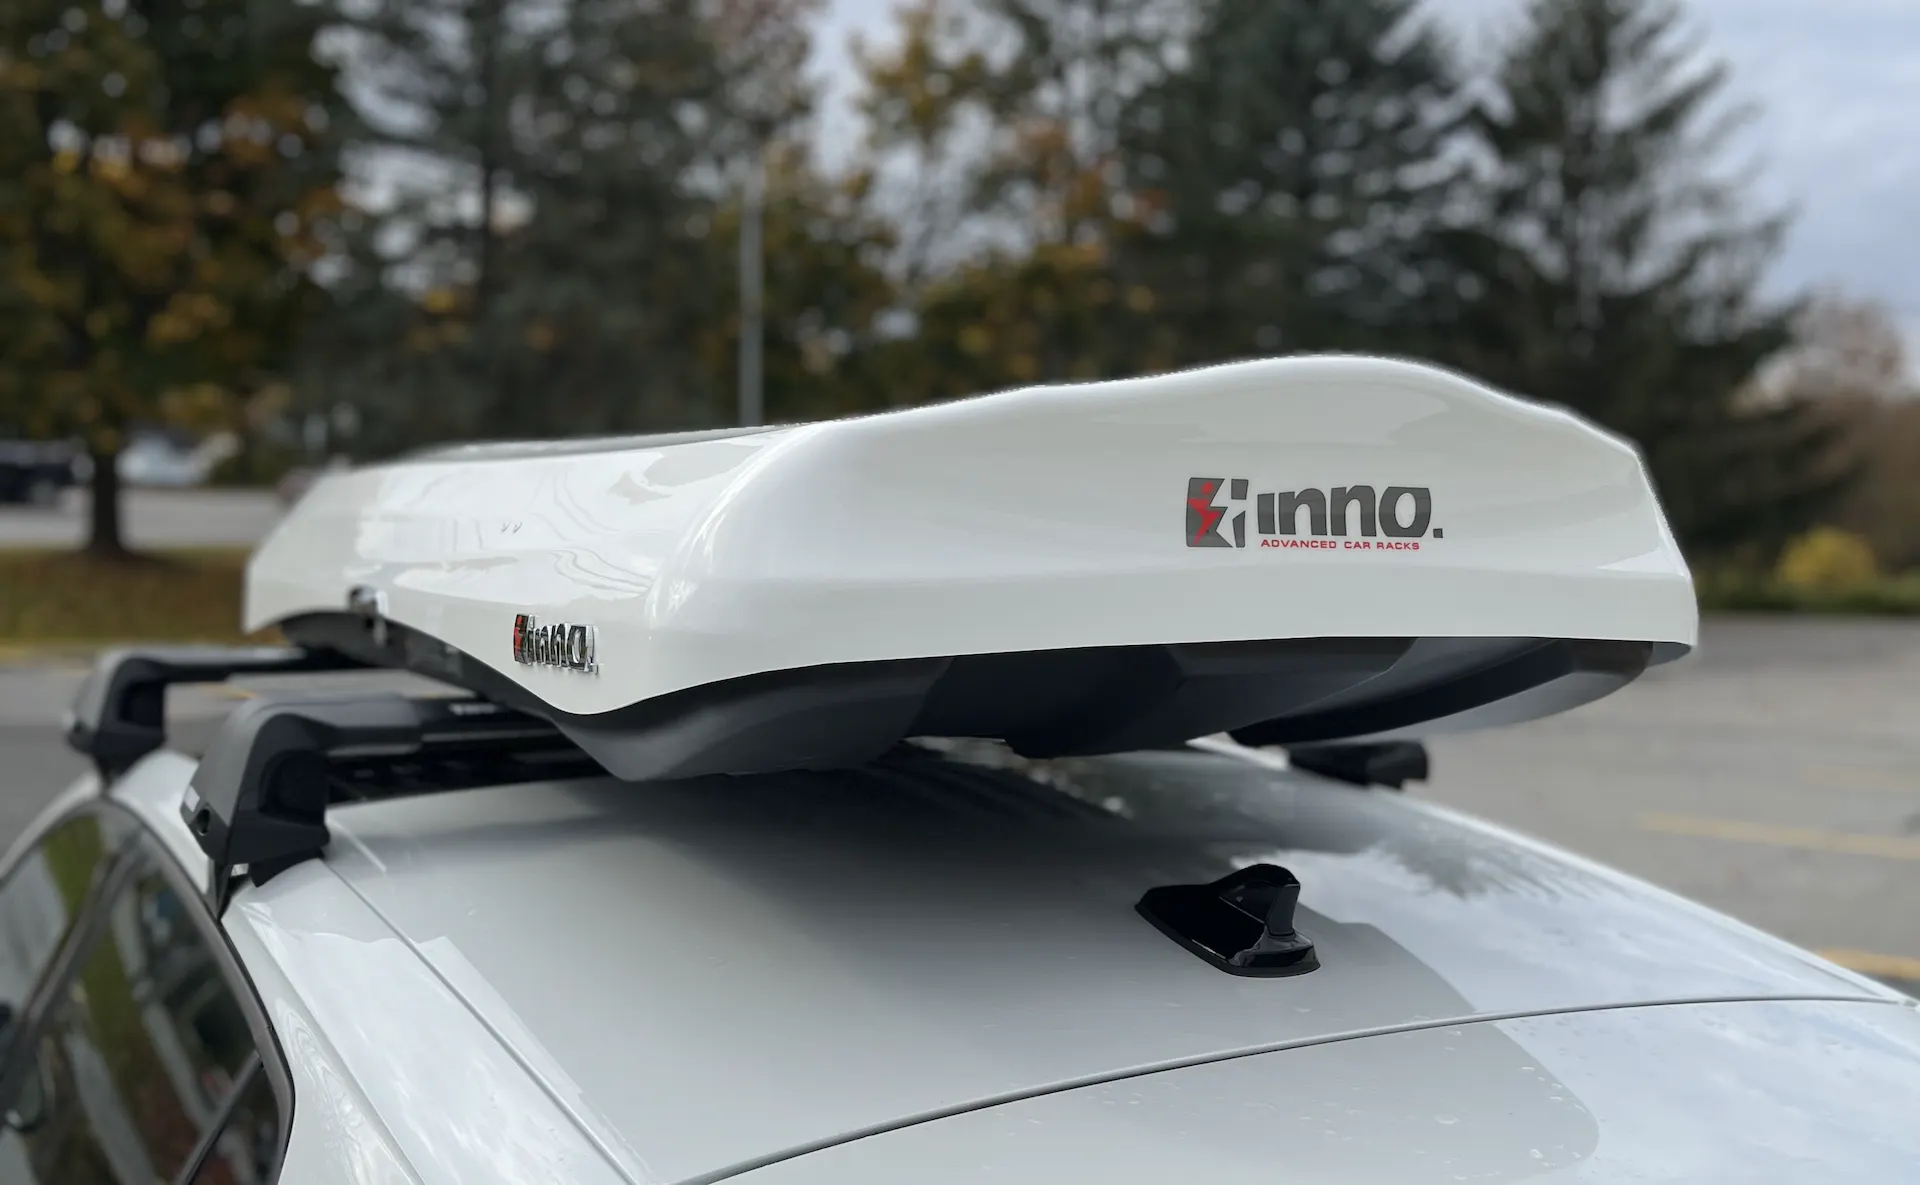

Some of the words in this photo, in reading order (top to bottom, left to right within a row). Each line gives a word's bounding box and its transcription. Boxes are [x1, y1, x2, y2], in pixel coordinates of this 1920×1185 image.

[1261, 539, 1337, 549] ADVANCED
[1344, 541, 1371, 550] CAR
[1376, 541, 1420, 550] RACKS
